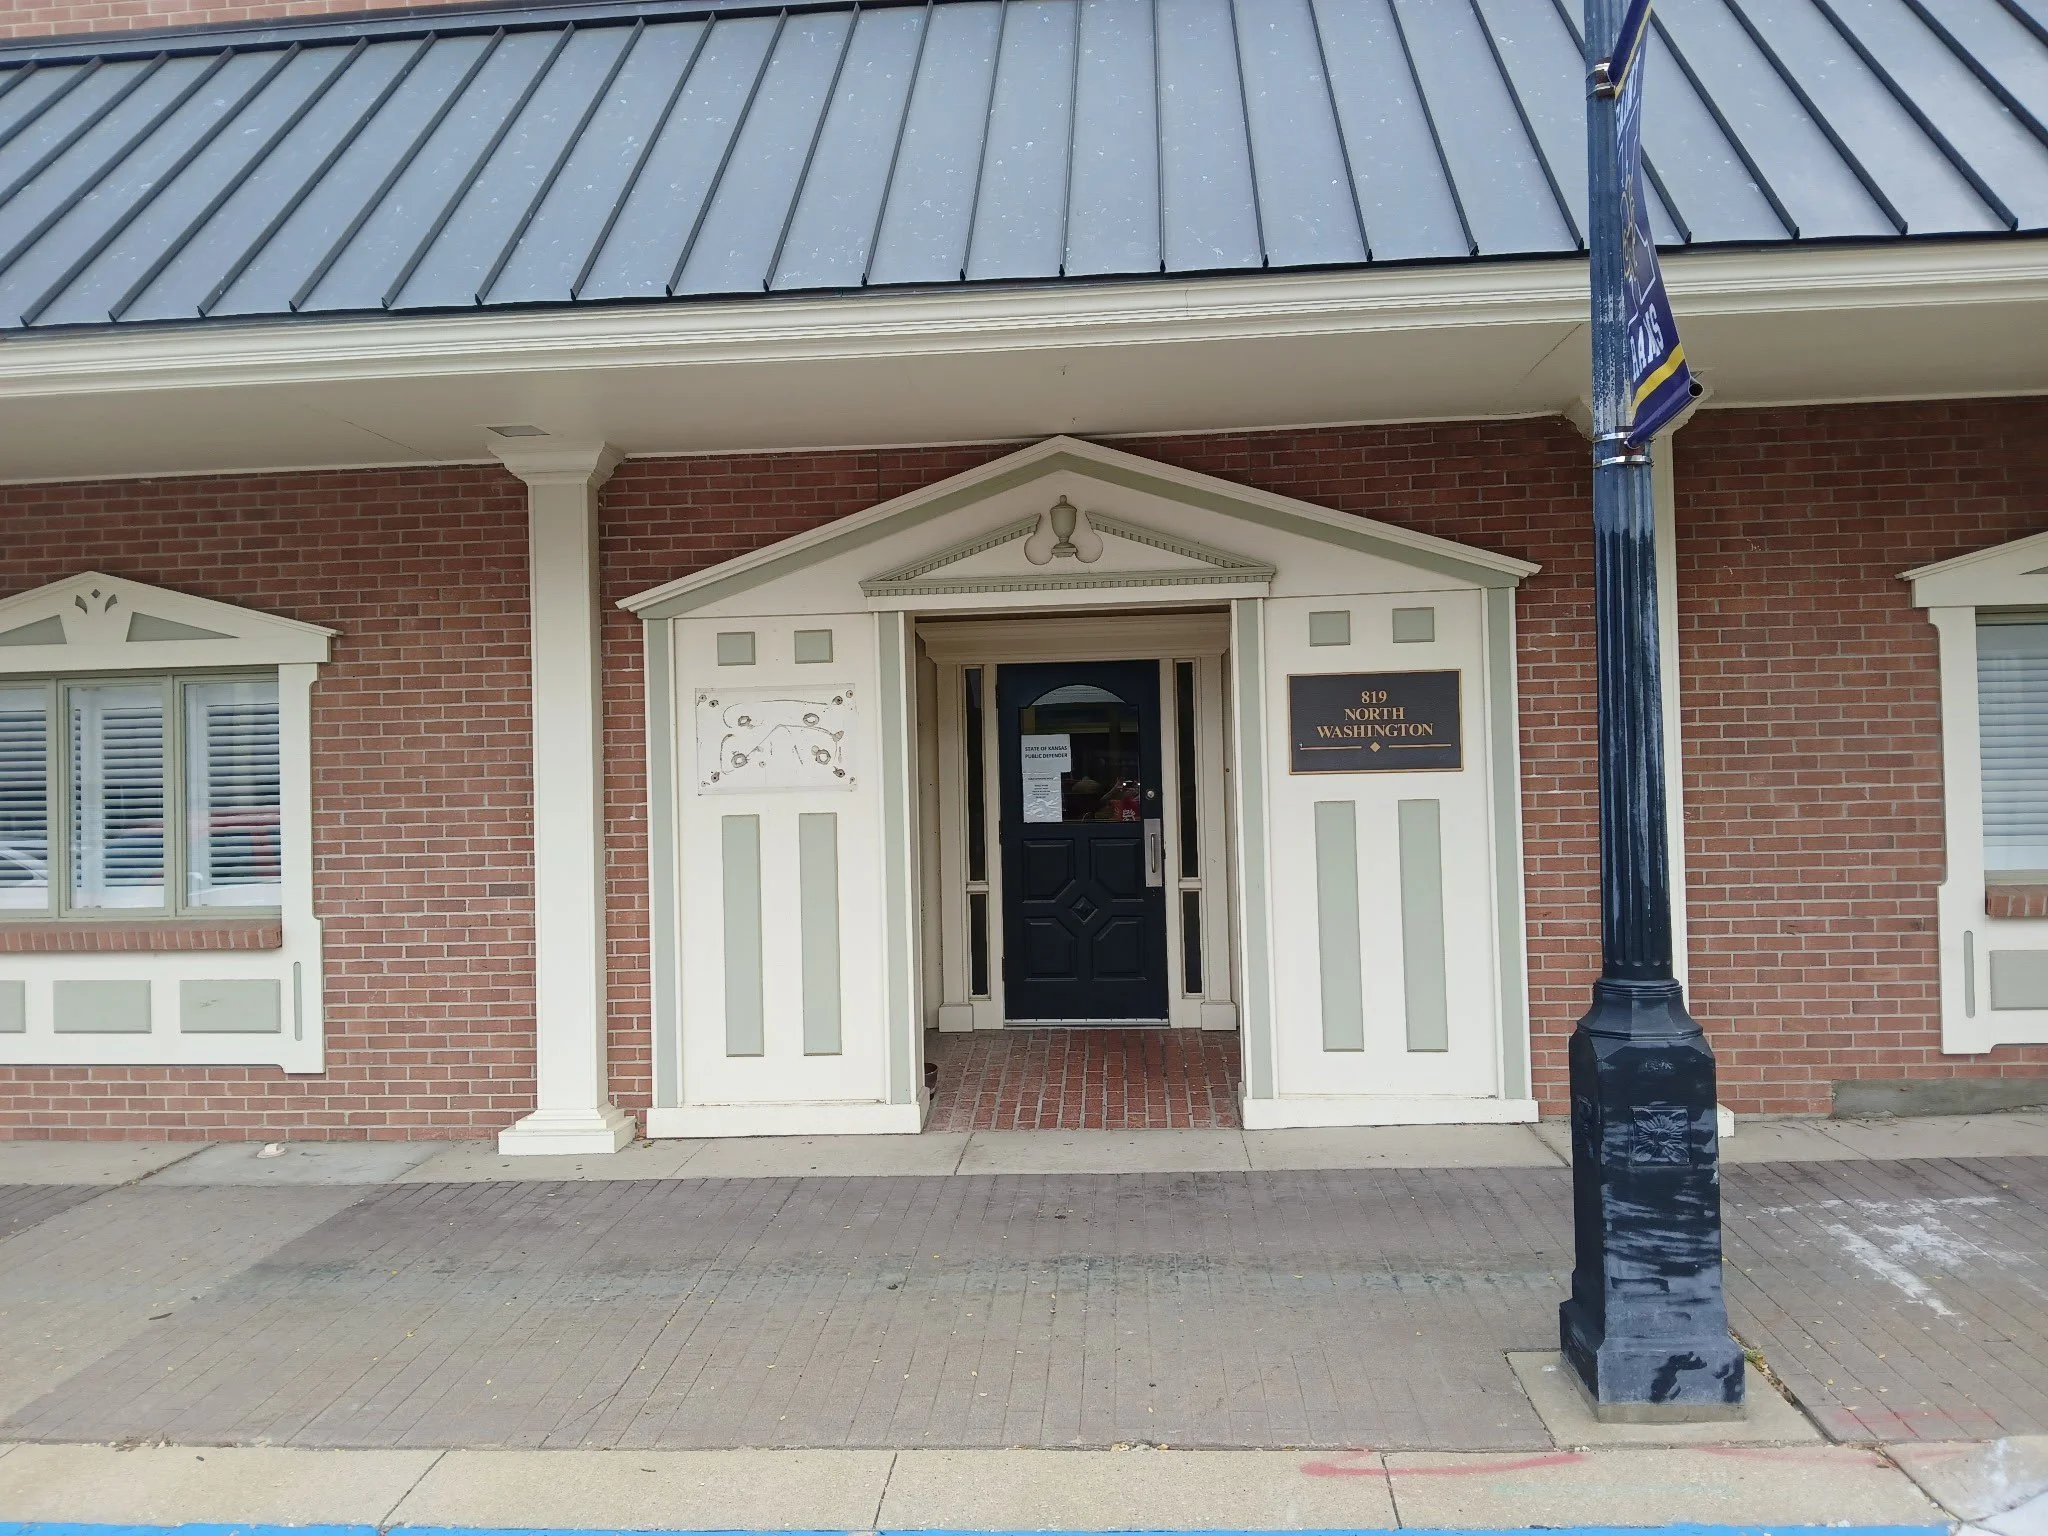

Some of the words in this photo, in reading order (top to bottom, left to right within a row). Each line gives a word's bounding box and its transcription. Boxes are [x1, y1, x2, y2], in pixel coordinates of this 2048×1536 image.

[1361, 690, 1387, 704] 819
[1344, 706, 1405, 721] NORTH
[1317, 723, 1433, 738] WASHINGTON
